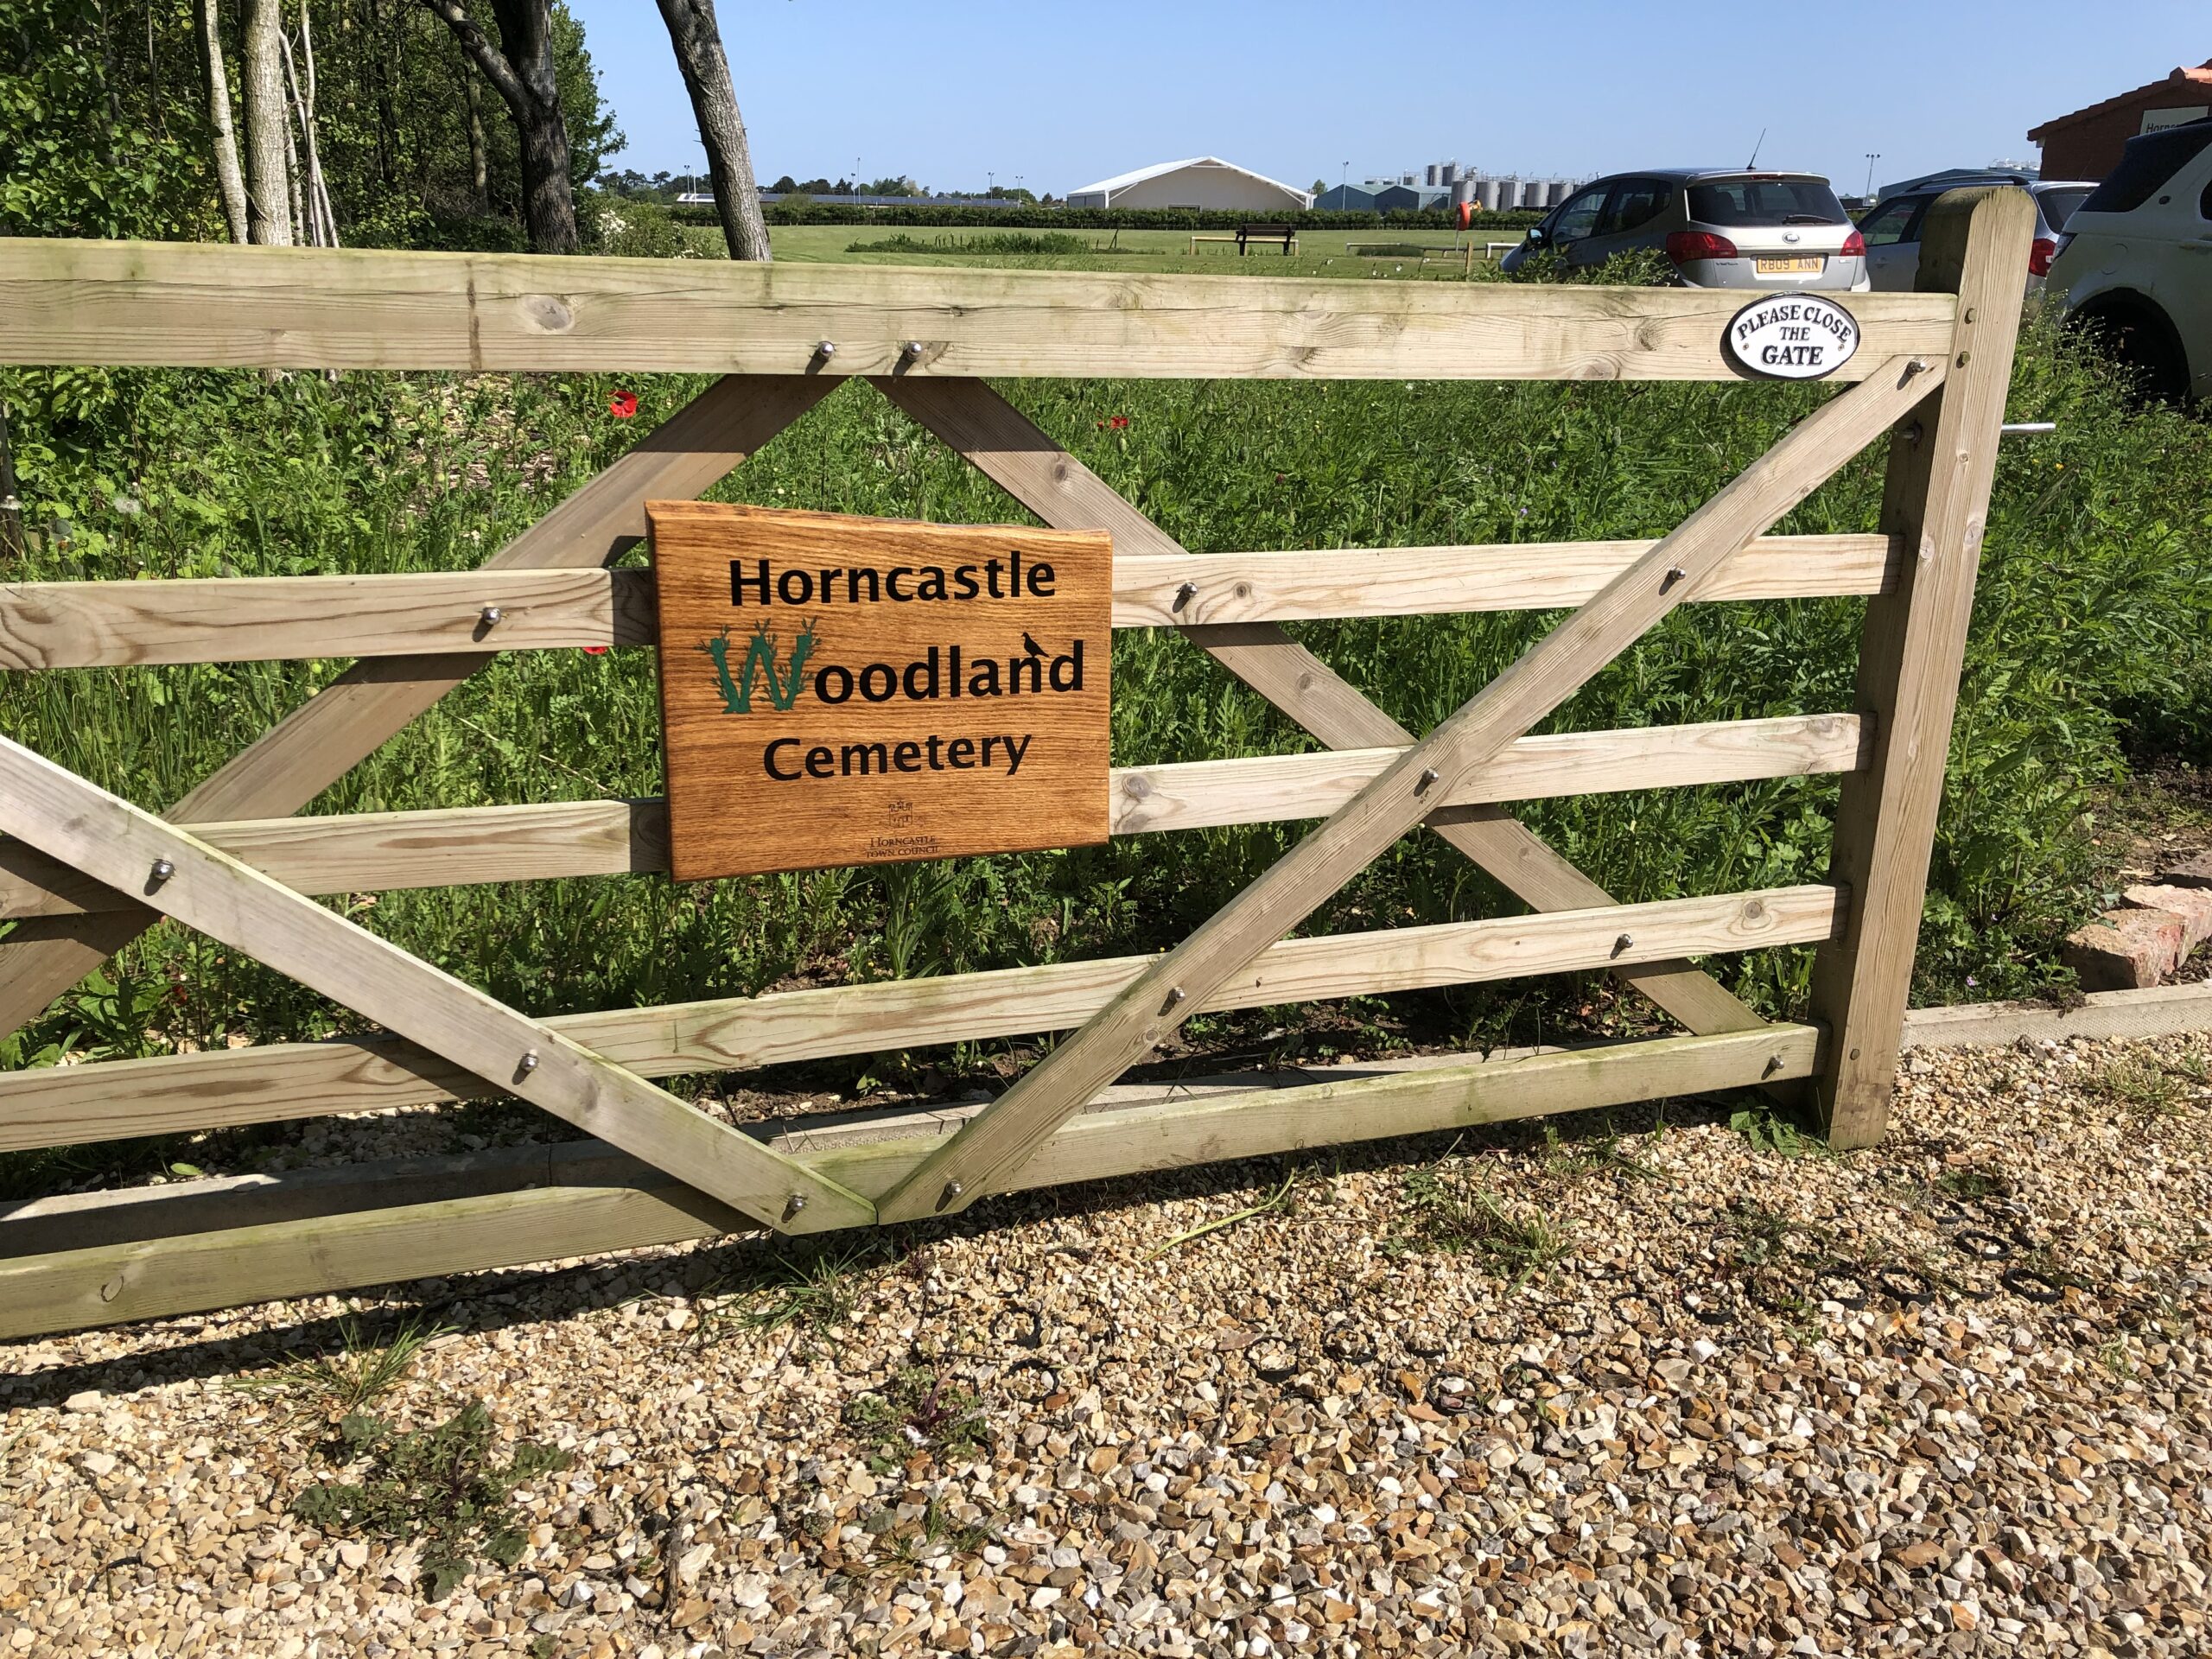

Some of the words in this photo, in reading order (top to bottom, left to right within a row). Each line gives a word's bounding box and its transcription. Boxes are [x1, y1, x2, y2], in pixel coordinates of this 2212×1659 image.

[1760, 258, 1790, 270] RB09
[1797, 257, 1819, 270] ANN
[1737, 304, 1802, 341] PLEASE
[1803, 306, 1853, 343] CLOSE
[1779, 326, 1811, 341] THE
[1761, 345, 1824, 366] GATE
[729, 550, 1057, 607] Horncastle
[695, 616, 1084, 715] Woodland
[763, 734, 1033, 781] Cemetery
[866, 849, 895, 859] TOWN
[898, 846, 940, 856] COUNCIL
